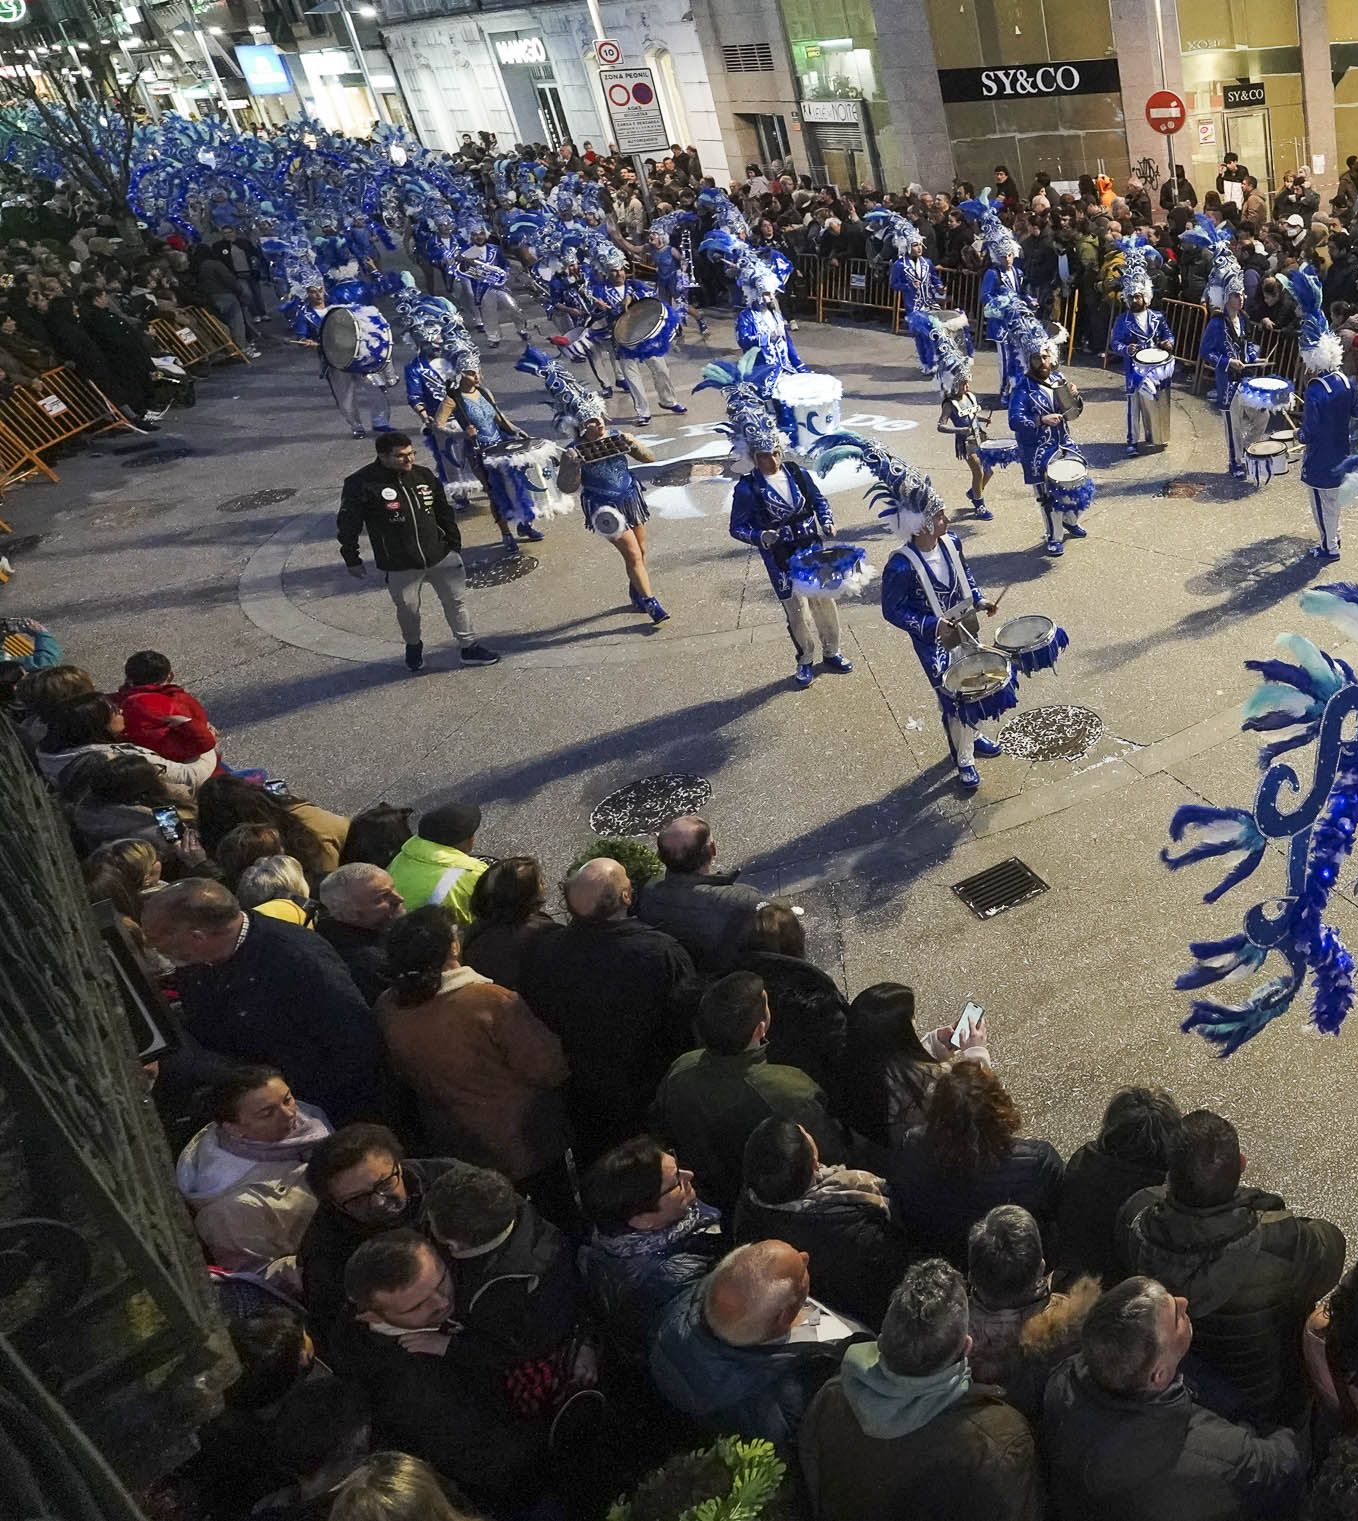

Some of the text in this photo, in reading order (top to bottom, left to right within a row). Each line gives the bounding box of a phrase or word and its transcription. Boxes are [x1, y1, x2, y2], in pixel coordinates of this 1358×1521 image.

[496, 37, 546, 64] MANGO
[603, 49, 615, 57] 10
[981, 65, 1080, 96] SY&CO
[1227, 88, 1264, 102] SY&CO
